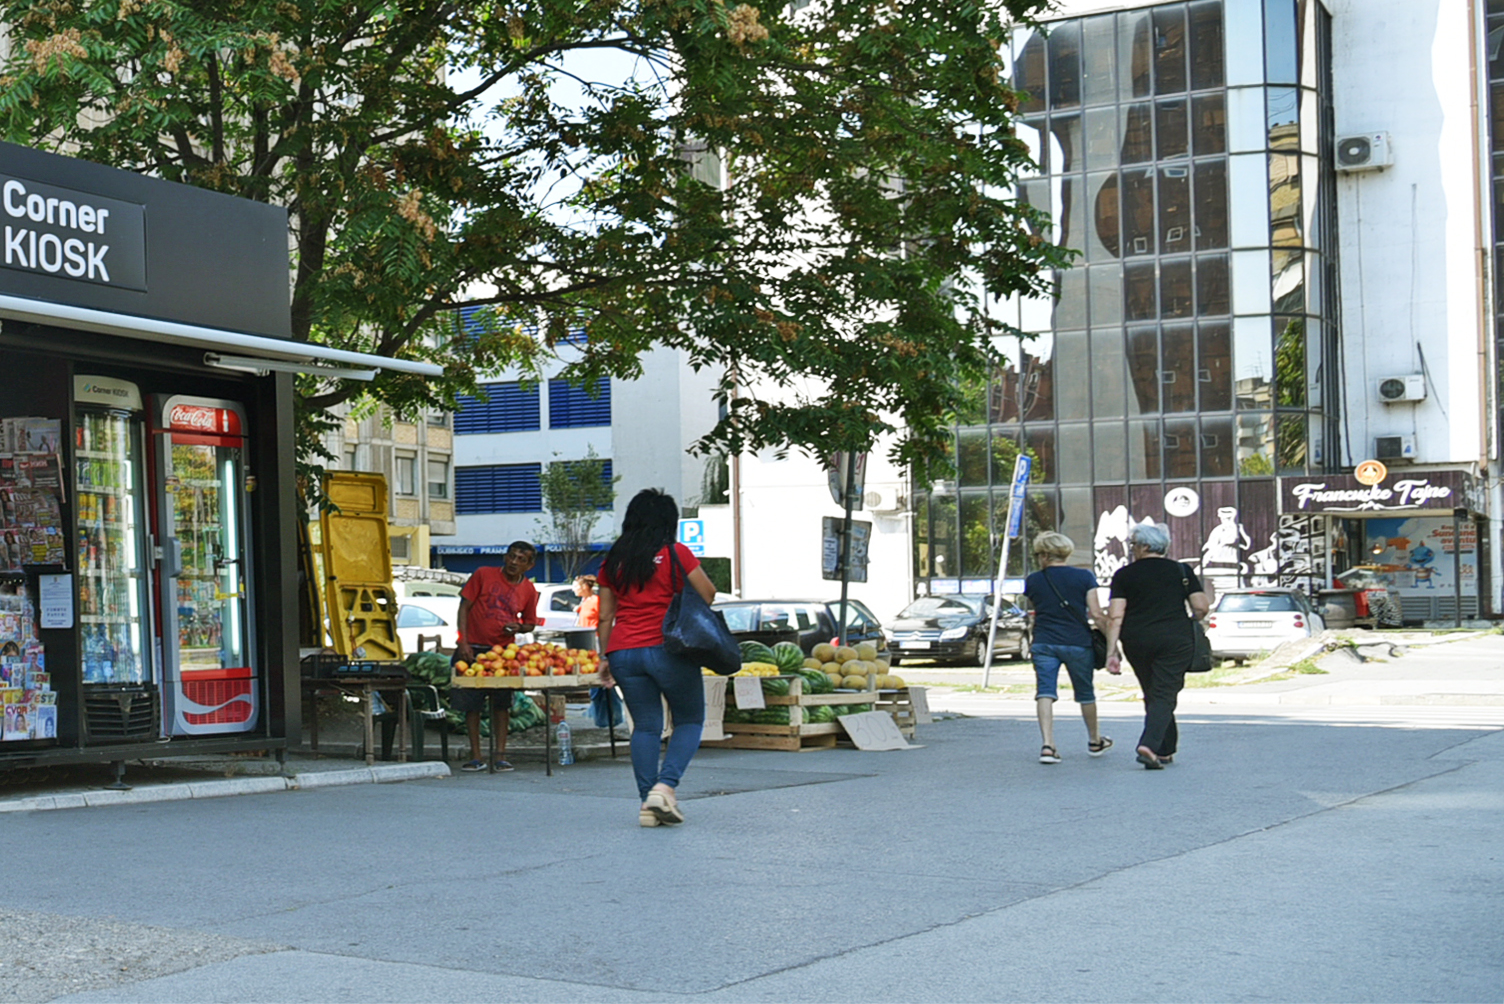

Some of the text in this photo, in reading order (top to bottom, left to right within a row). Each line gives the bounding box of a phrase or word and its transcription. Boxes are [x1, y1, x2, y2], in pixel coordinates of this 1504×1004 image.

[3, 180, 110, 235] Corner
[4, 225, 110, 282] KIOSK
[1292, 479, 1452, 510] Francuske Tajne
[684, 522, 700, 542] P
